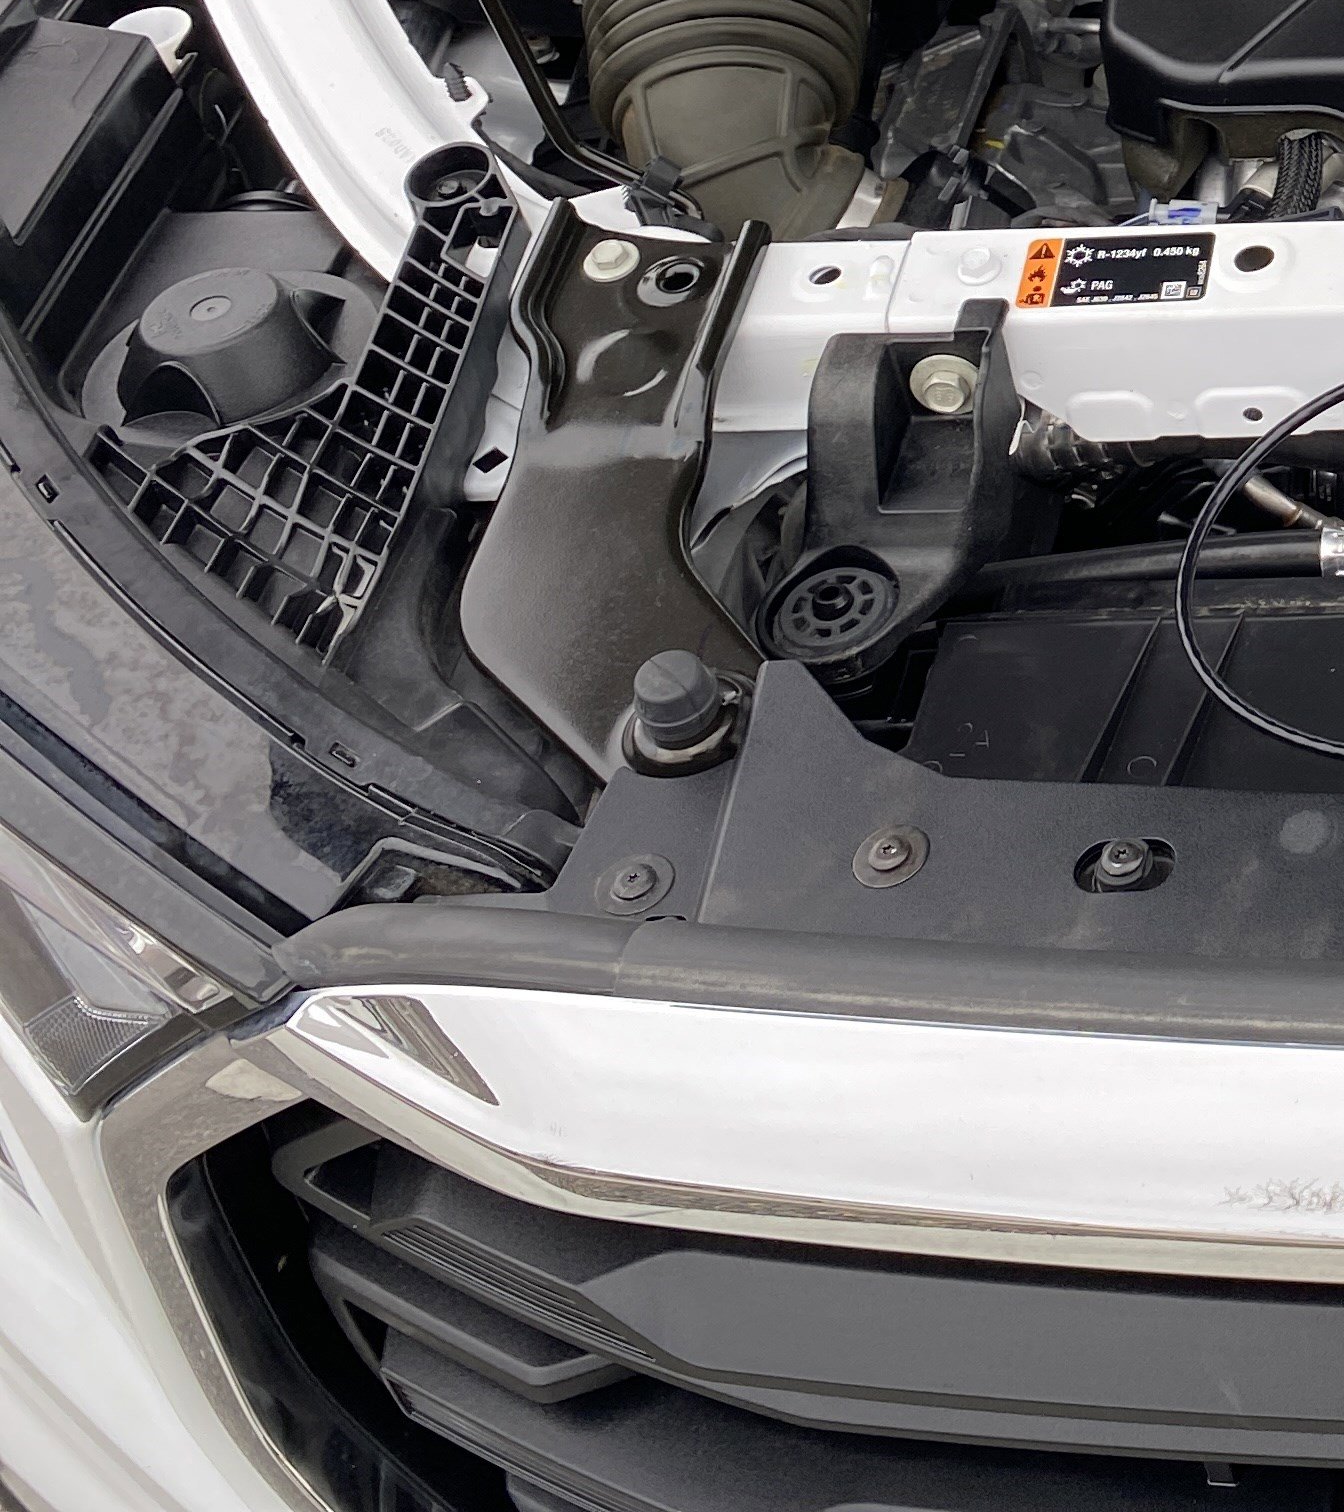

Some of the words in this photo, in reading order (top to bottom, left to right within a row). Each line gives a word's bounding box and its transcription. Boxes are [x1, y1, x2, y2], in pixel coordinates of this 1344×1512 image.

[1097, 248, 1147, 260] R-1234yf
[1153, 246, 1183, 257] 0.450
[1185, 245, 1200, 257] kg
[1090, 280, 1113, 291] PAG
